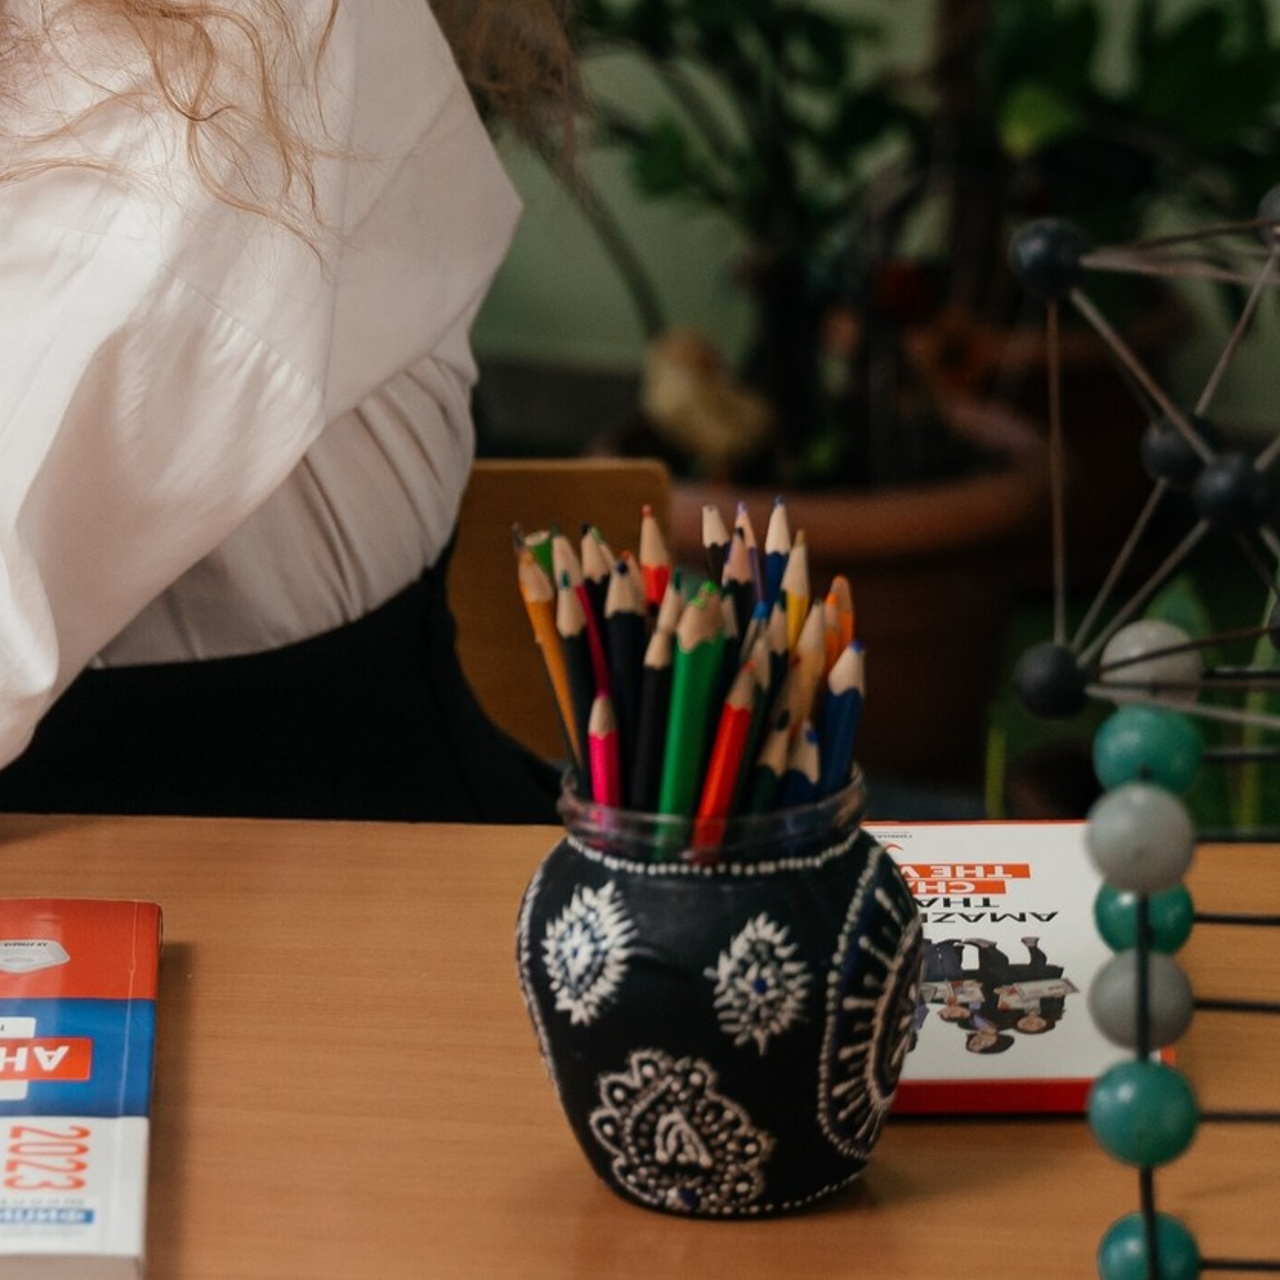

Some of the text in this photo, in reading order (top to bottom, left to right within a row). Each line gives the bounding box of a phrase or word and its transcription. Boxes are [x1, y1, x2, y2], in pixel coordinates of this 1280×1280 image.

[930, 865, 1013, 878] THE
[913, 897, 1000, 908] THA
[920, 911, 1059, 923] AMAZI
[4, 1126, 91, 1191] 2023
